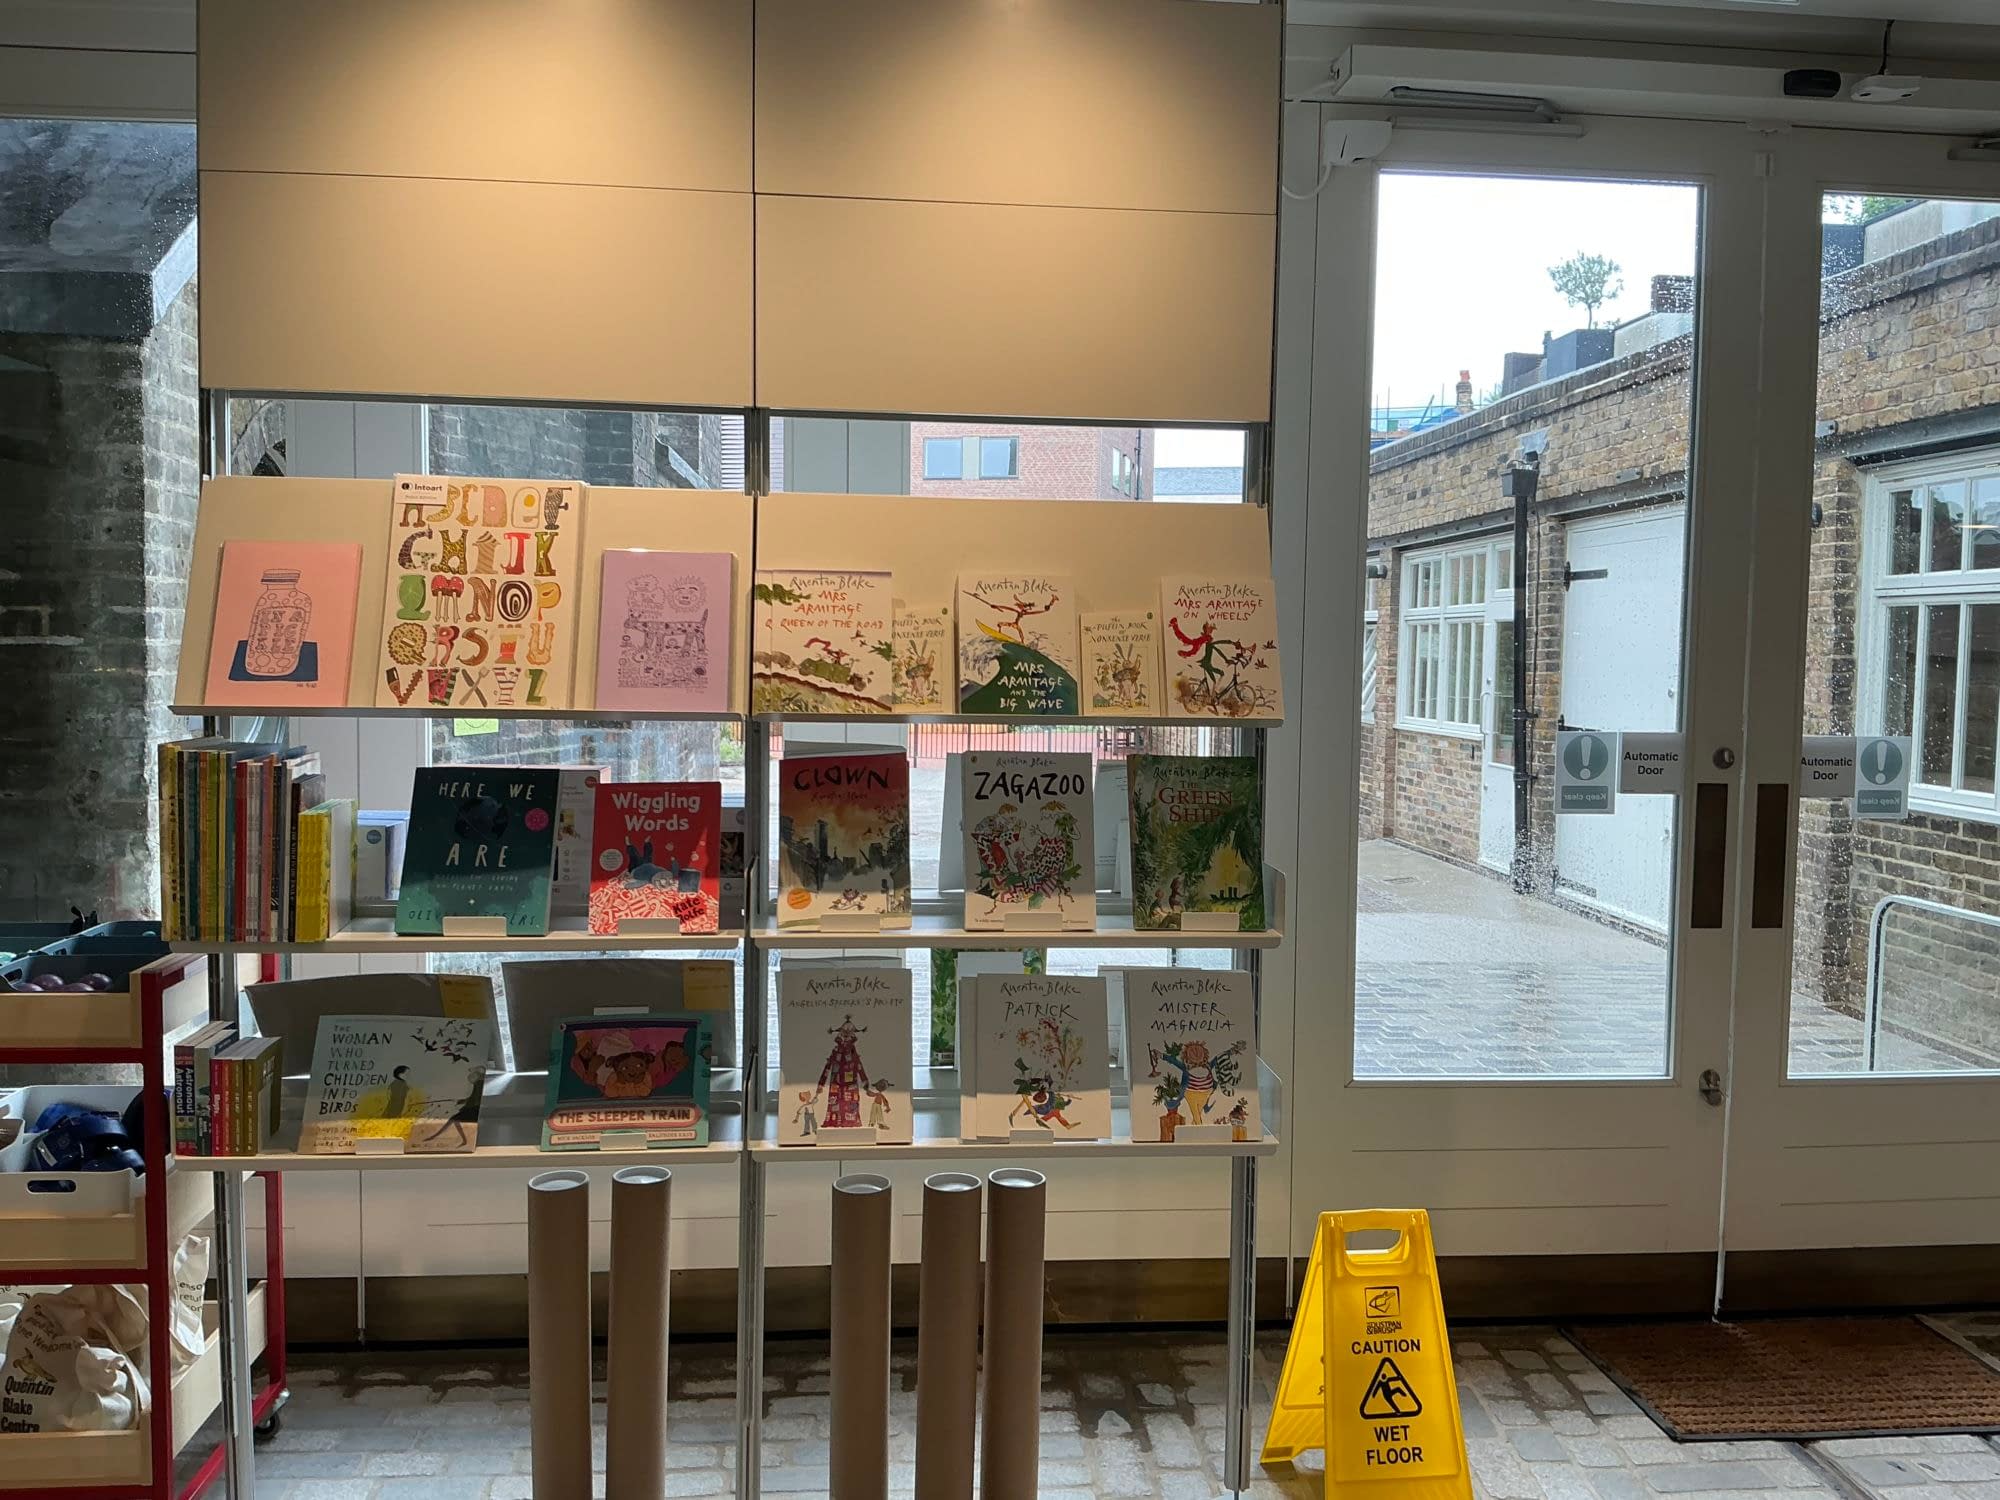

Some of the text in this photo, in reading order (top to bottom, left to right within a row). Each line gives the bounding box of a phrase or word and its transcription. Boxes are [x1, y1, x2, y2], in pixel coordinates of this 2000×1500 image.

[414, 483, 442, 492] Intoart
[790, 574, 875, 591] Quentin Blake
[975, 577, 1058, 595] Quentin Blake
[1178, 582, 1260, 599] Quentin Blake
[818, 590, 847, 602] MRS
[794, 603, 863, 619] ARMITAGE
[1174, 599, 1264, 613] MRS ARMITAGE
[1208, 611, 1251, 622] WHEELS
[780, 619, 814, 633] QUEEN
[817, 619, 829, 628] OF
[832, 619, 851, 628] THE
[856, 620, 883, 630] ROAD
[1013, 661, 1045, 674] MRS
[997, 676, 1064, 692] ARMITAGE
[1032, 689, 1047, 697] THE
[999, 699, 1064, 712] BIG WAVE
[1623, 752, 1679, 761] Automatic
[1801, 757, 1853, 767] Automatic
[793, 765, 890, 791] CLOWN
[1153, 766, 1240, 782] Quentin Blake
[1637, 765, 1665, 775] Door
[1813, 771, 1839, 780] Door
[439, 782, 535, 800] HERE WE
[974, 771, 1085, 803] ZAGAZOO
[612, 792, 701, 813] Wiggling
[1158, 787, 1232, 806] GREEN
[1169, 805, 1222, 823] SHIP
[624, 814, 690, 831] Words
[446, 843, 508, 867] ARE
[673, 897, 701, 915] Kate
[677, 907, 705, 923] Rolfe
[806, 976, 891, 993] Quentin Blake
[1001, 979, 1081, 996] Quentin Blake
[1151, 978, 1232, 996] Quentin Blake
[1005, 1001, 1081, 1021] PATRICK
[1158, 1002, 1226, 1017] MISTER
[1150, 1019, 1236, 1037] MAGNOLIA
[332, 1033, 393, 1045] WOMAN
[330, 1048, 363, 1058] WHO
[327, 1060, 375, 1072] TURNED
[324, 1073, 388, 1086] CHILDREN
[322, 1088, 358, 1100] INTO
[319, 1101, 359, 1115] BIRDS
[558, 1108, 691, 1124] THE SLEEPER TRAIN
[1351, 1339, 1421, 1354] CAUTION
[5, 1376, 54, 1396] Quentin
[3, 1398, 33, 1415] Blake
[1, 1417, 40, 1433] Centre
[1374, 1425, 1410, 1442] WET
[1366, 1447, 1424, 1465] FLOOR
